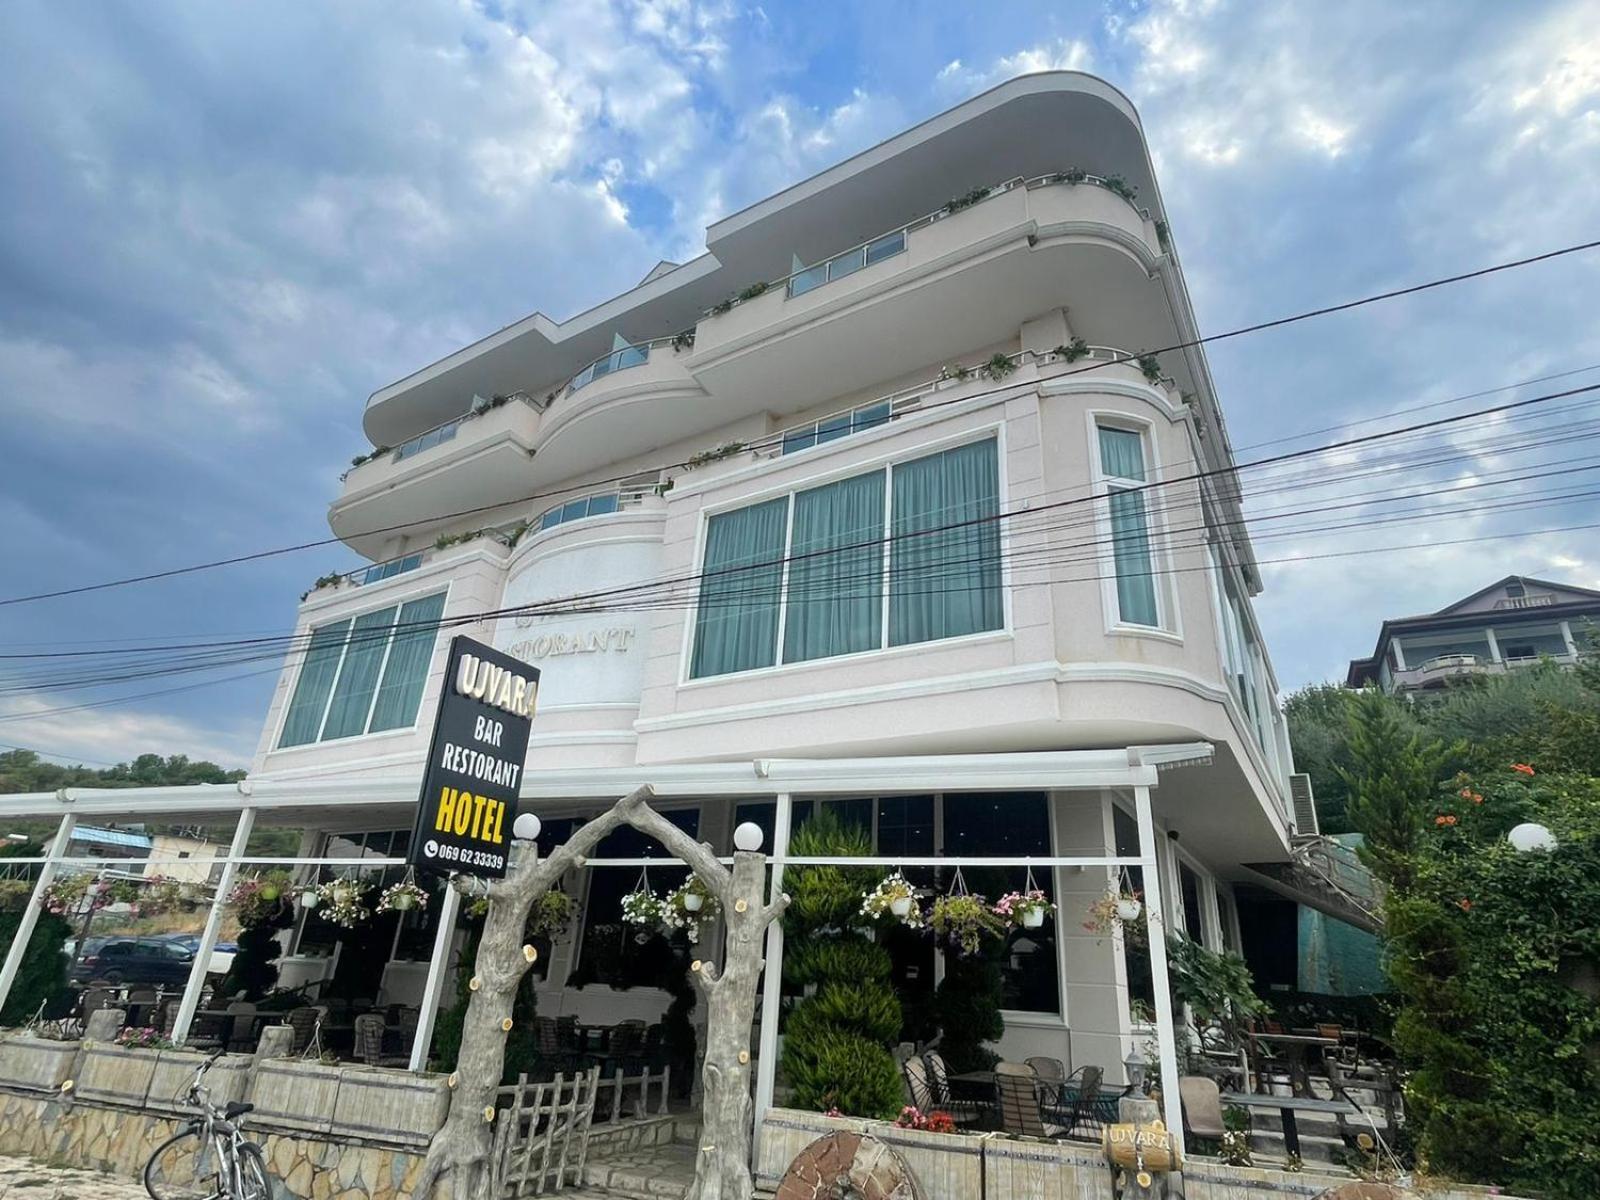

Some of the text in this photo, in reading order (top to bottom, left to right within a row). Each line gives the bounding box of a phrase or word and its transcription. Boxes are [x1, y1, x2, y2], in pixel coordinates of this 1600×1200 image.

[504, 627, 637, 662] STORANT
[455, 653, 538, 719] UJVARA
[473, 715, 504, 748] BAR
[441, 743, 519, 788] RESTORANT
[435, 786, 506, 844] HOTEL
[438, 843, 504, 870] 069 62 33339
[1109, 1129, 1171, 1150] UJVARA
